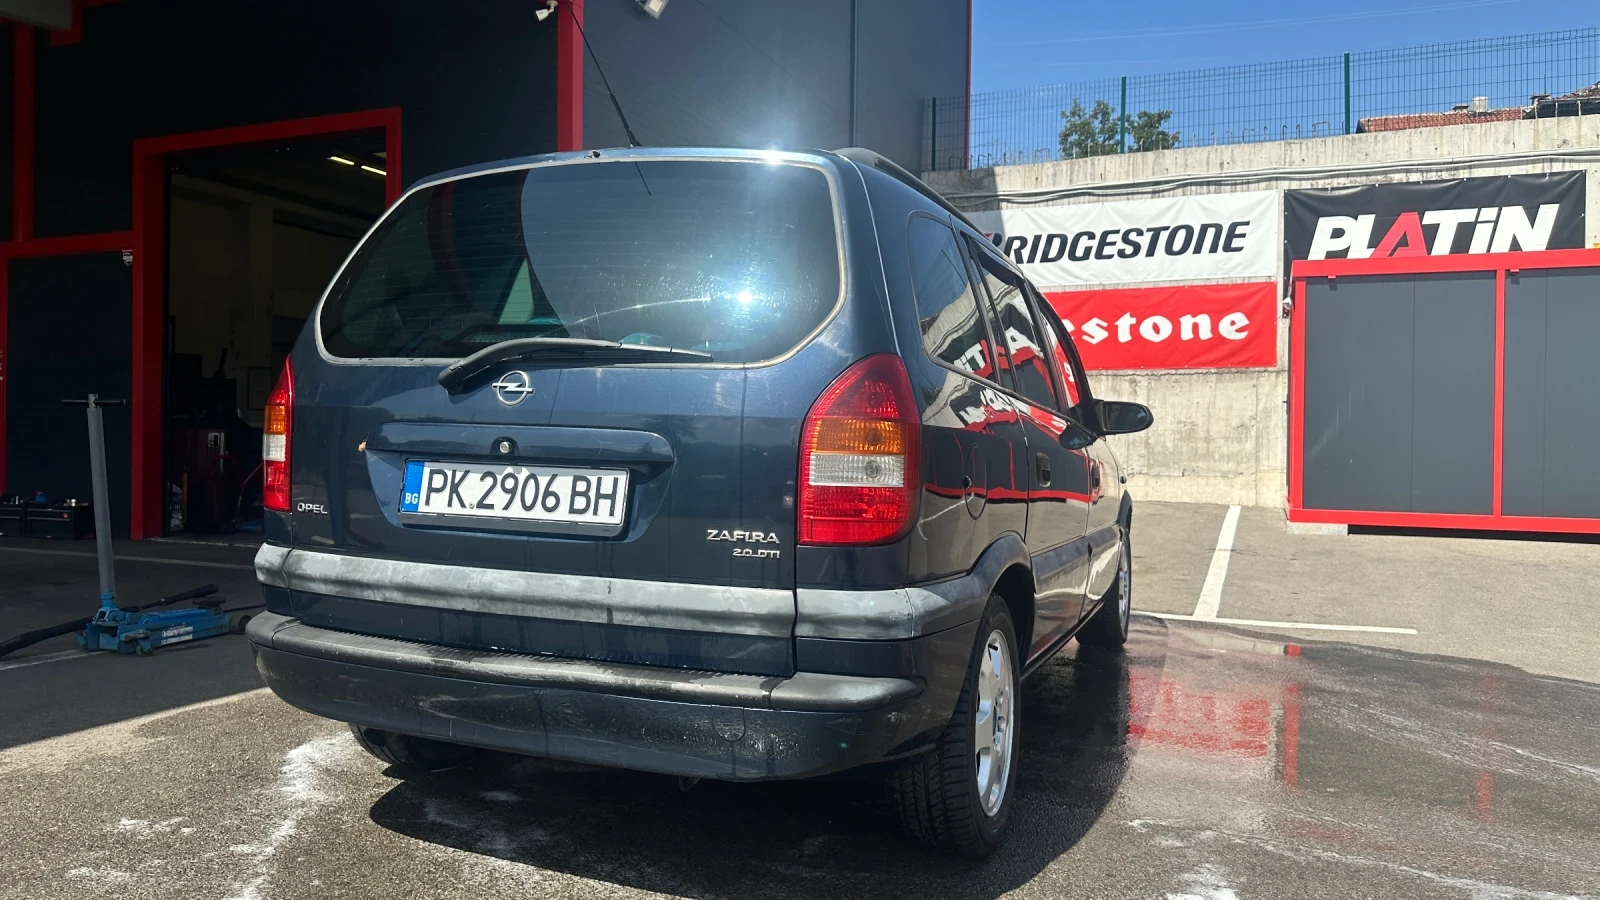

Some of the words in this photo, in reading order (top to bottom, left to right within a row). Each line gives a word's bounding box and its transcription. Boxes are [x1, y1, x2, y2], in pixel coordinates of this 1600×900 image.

[405, 493, 419, 505] BG
[475, 471, 561, 513] 2906
[568, 475, 619, 517] BH
[297, 502, 328, 514] OPEL
[706, 529, 780, 543] ZAFIRA
[757, 549, 781, 559] DTI
